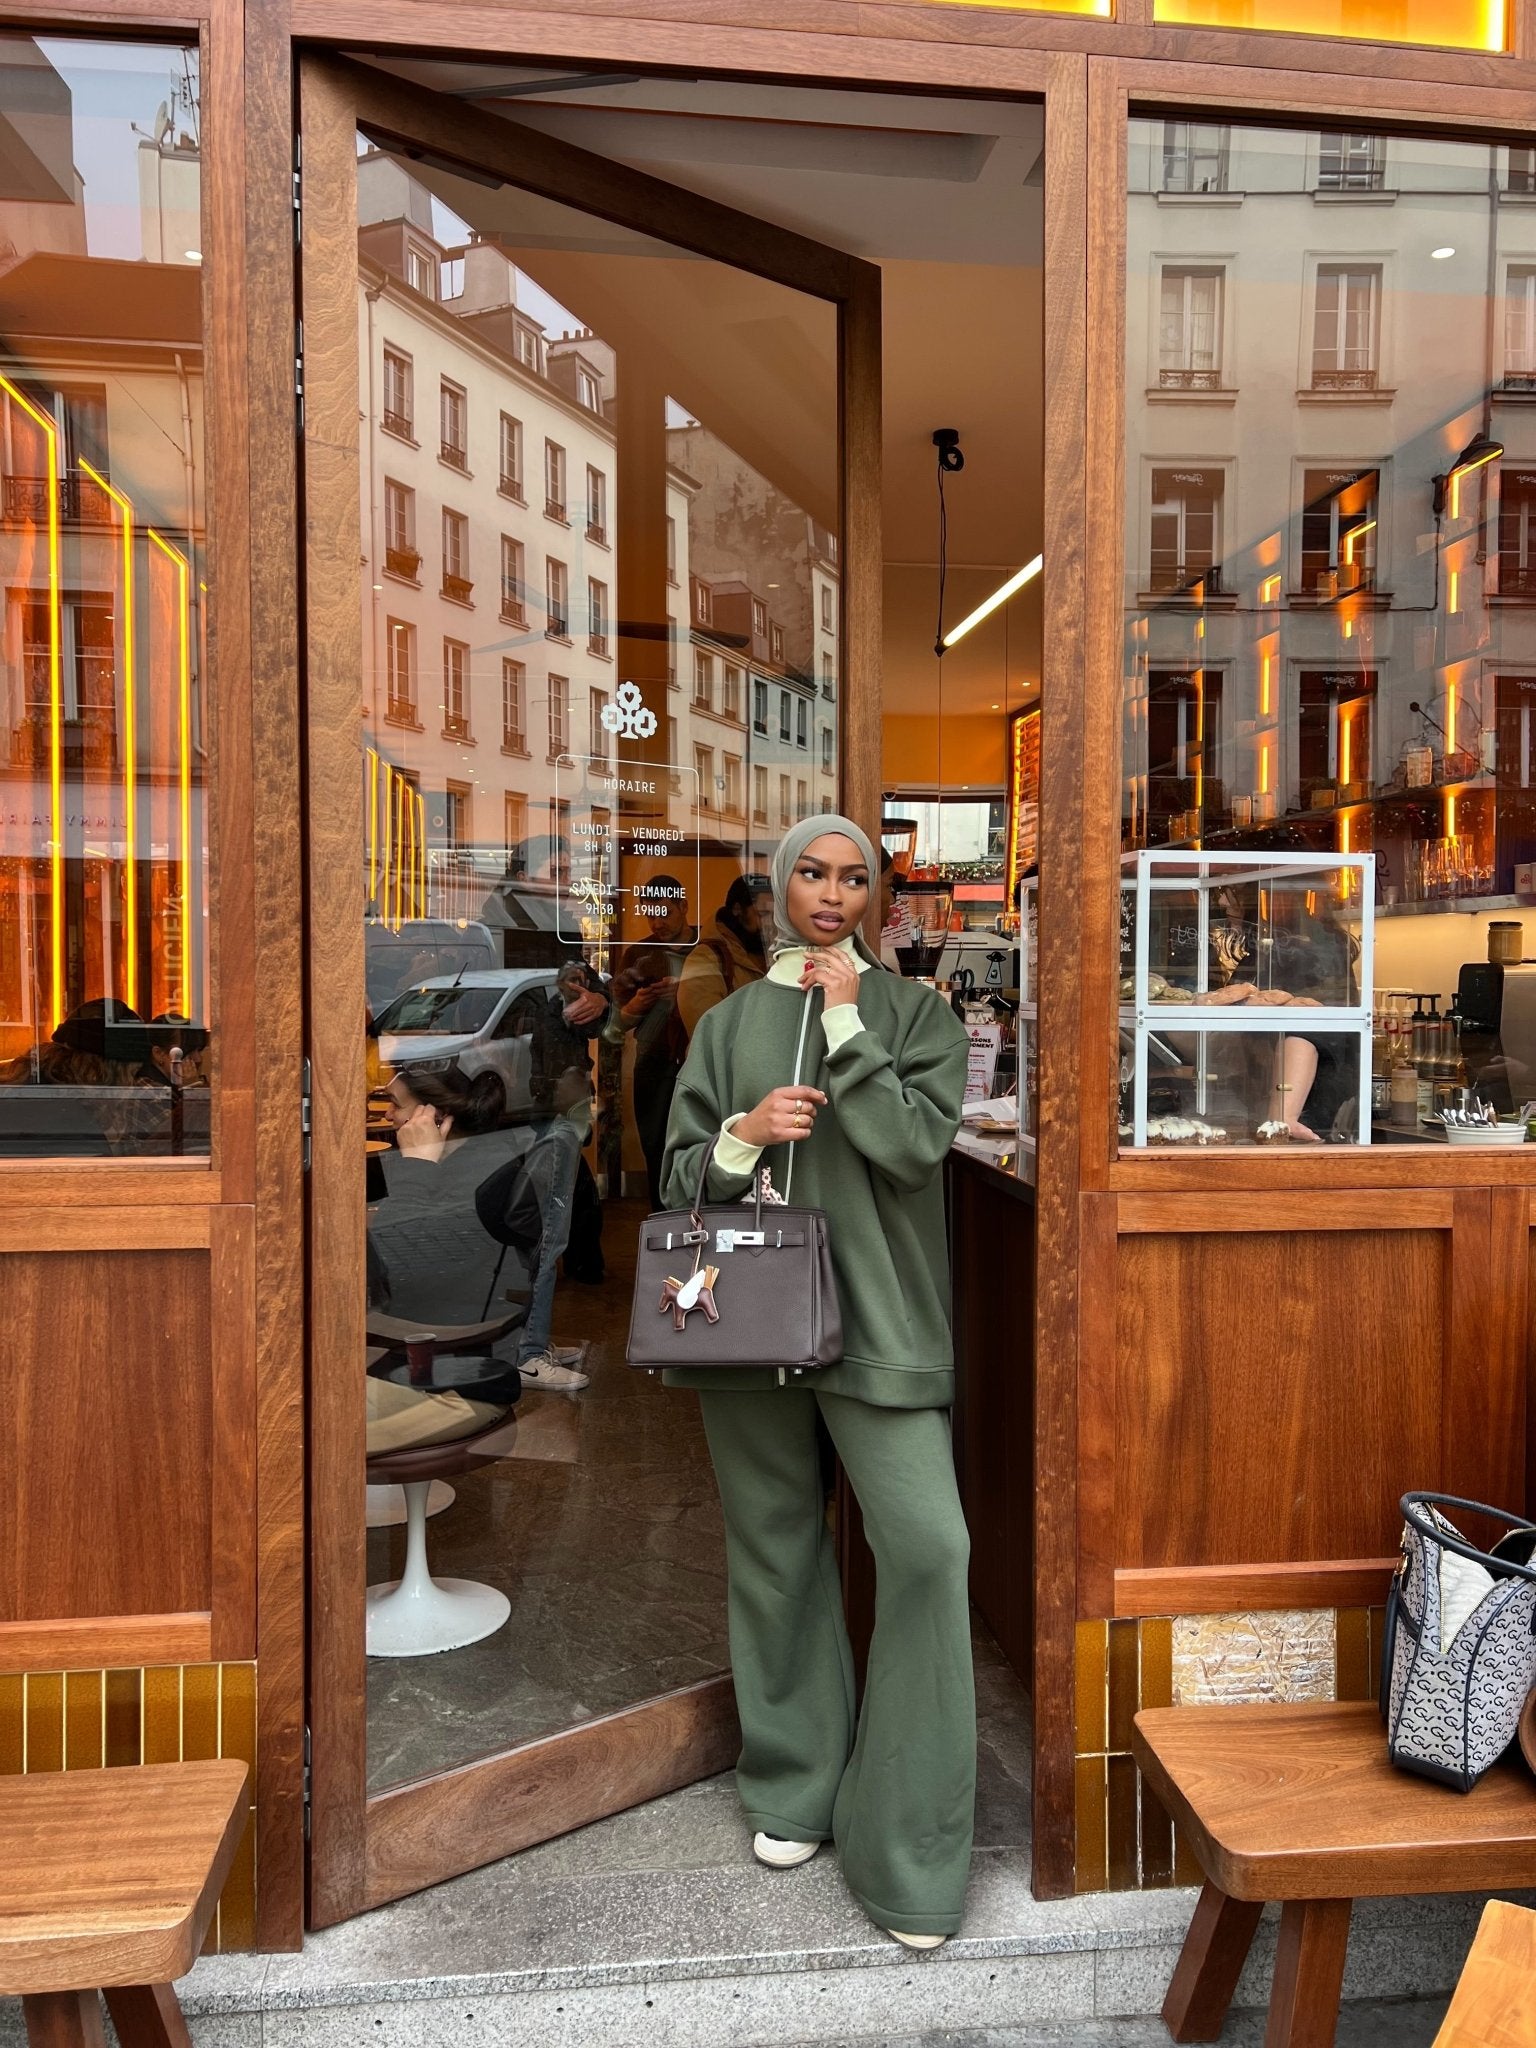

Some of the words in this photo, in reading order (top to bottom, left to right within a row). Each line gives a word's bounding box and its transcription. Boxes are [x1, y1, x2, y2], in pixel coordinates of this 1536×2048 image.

[603, 778, 656, 794] HORAIRE
[572, 822, 610, 837] LUNDI
[632, 826, 685, 842] VENDREDI
[584, 840, 612, 853] 8H0
[633, 885, 686, 899] DIMANCHE
[585, 903, 614, 915] 9H30
[634, 904, 668, 917] 19H00
